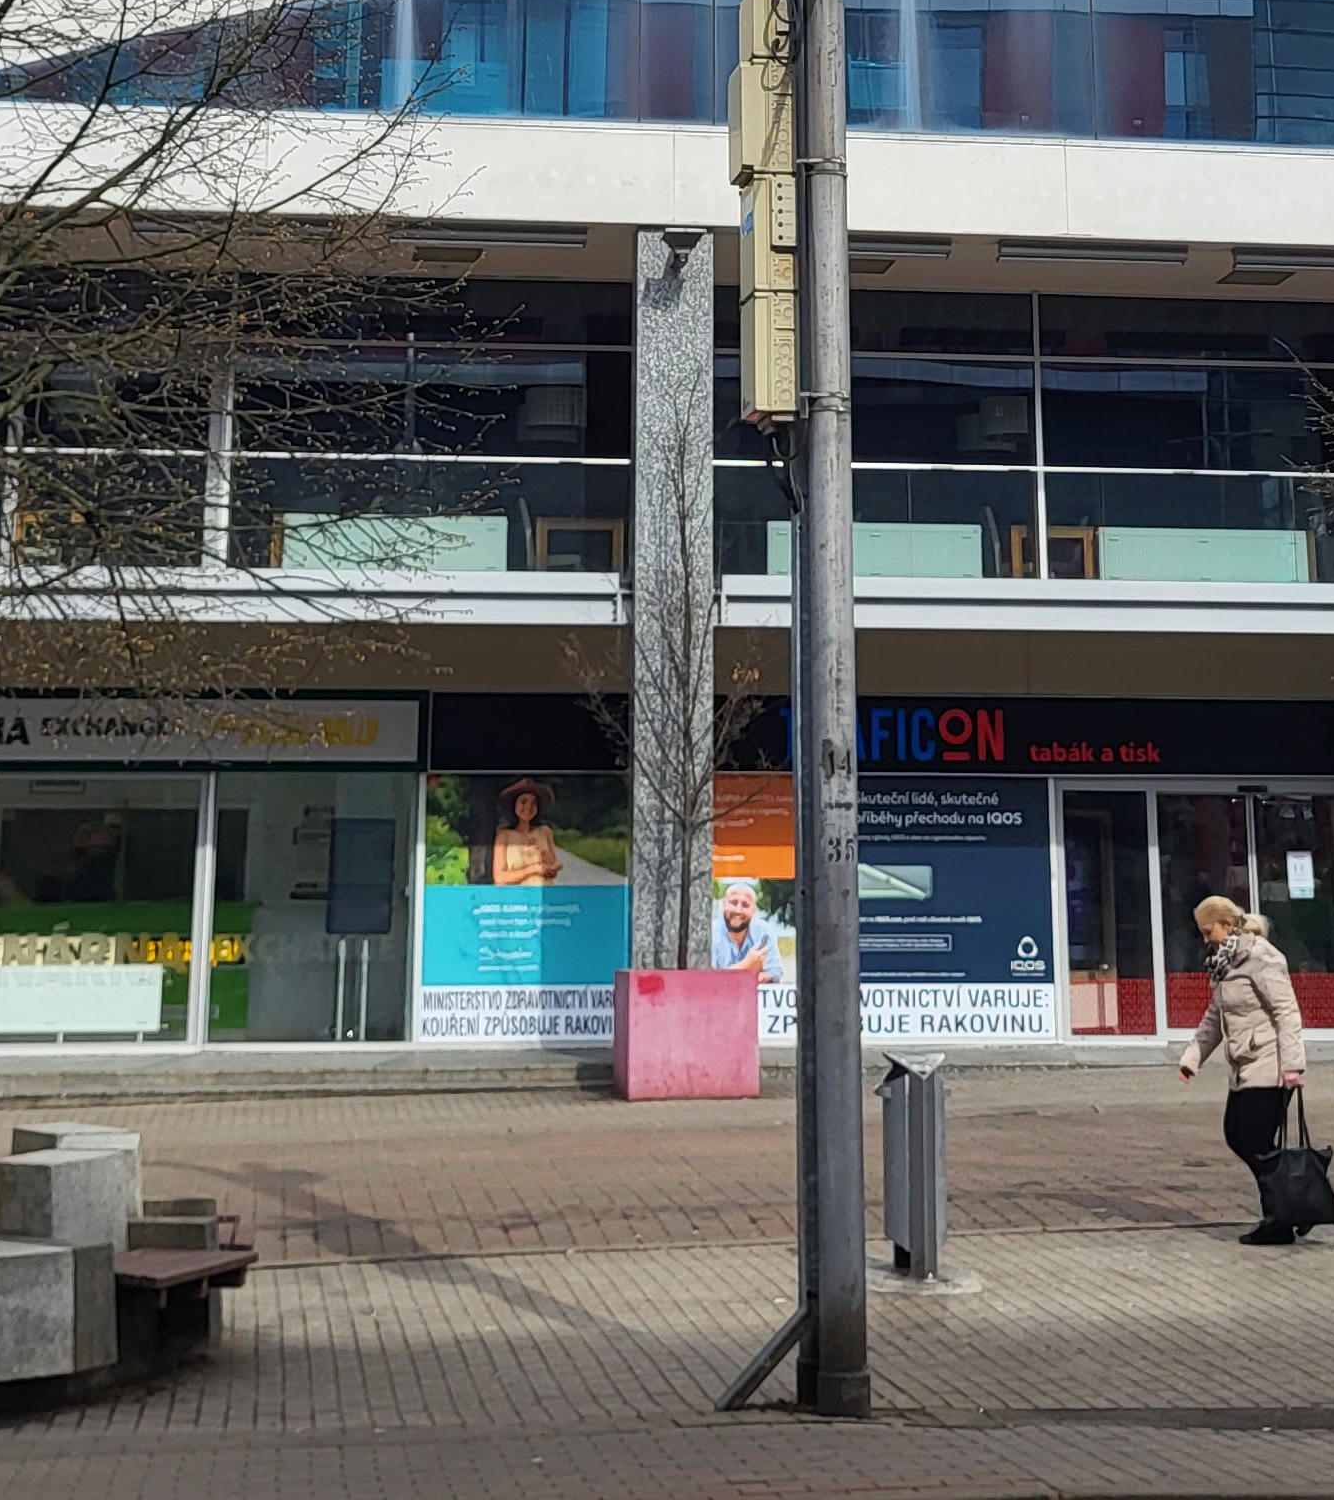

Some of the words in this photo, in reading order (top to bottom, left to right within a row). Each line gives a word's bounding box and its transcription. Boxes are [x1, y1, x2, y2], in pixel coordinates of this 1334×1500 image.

[779, 706, 1005, 762] TFICON
[1030, 741, 1094, 763] tabák
[1100, 747, 1114, 763] a
[1118, 741, 1161, 763] tisk
[967, 814, 984, 825] na
[986, 811, 1023, 826] IQOS
[423, 990, 502, 1011] MINISTERSTVO
[968, 989, 1050, 1009] VARUJE:
[860, 1014, 911, 1034] UJE
[920, 1014, 1051, 1034] RAKOVINU.
